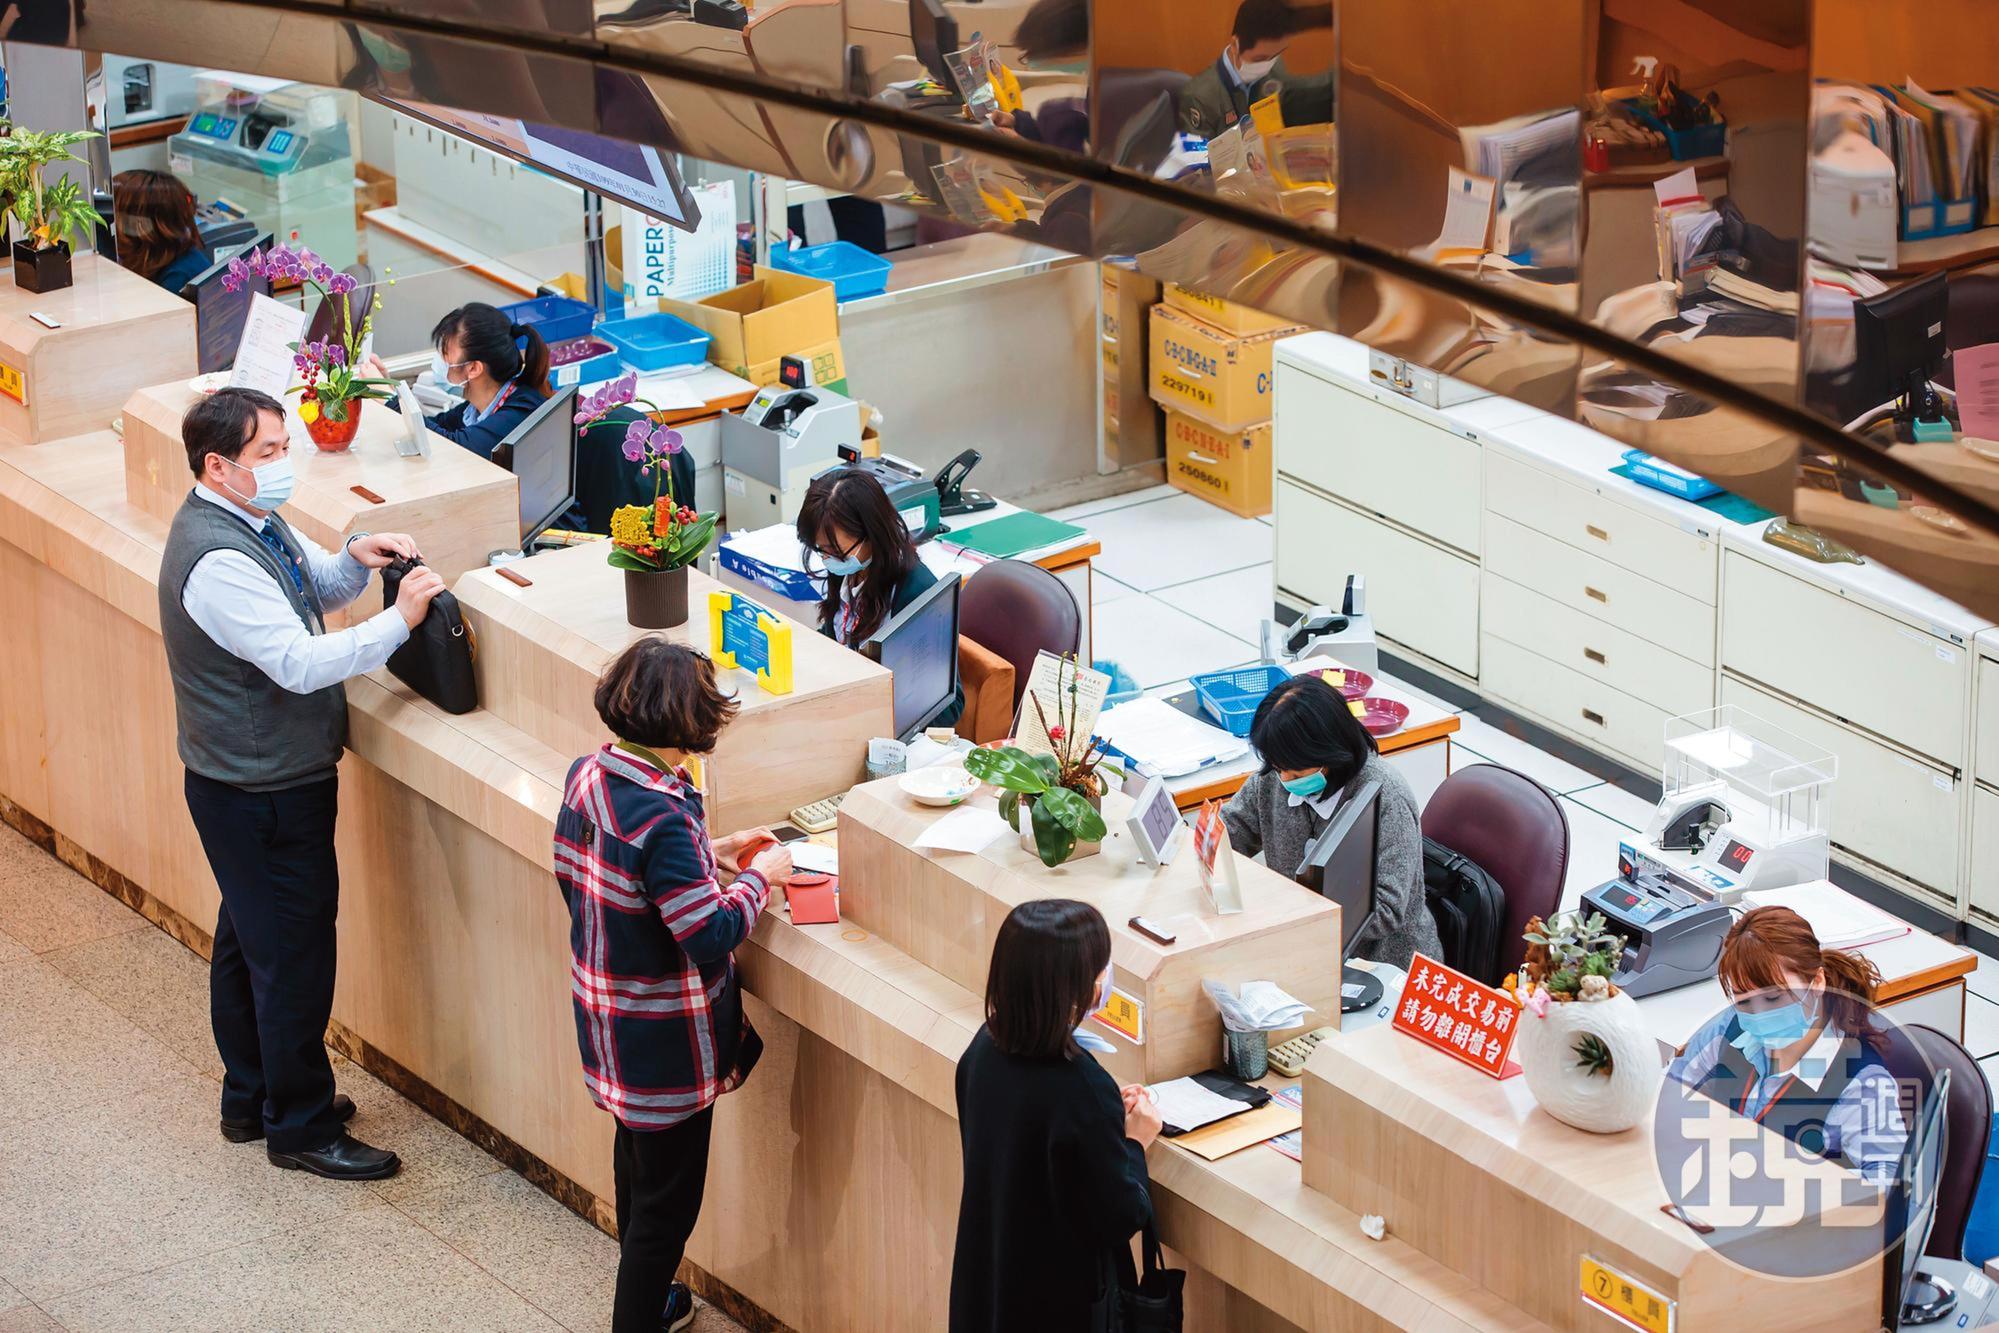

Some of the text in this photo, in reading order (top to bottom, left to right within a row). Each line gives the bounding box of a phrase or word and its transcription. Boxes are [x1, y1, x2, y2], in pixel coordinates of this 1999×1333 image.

[1402, 997, 1502, 1064] 請勿離開櫃台
[1412, 966, 1514, 1033] 未完成交易前
